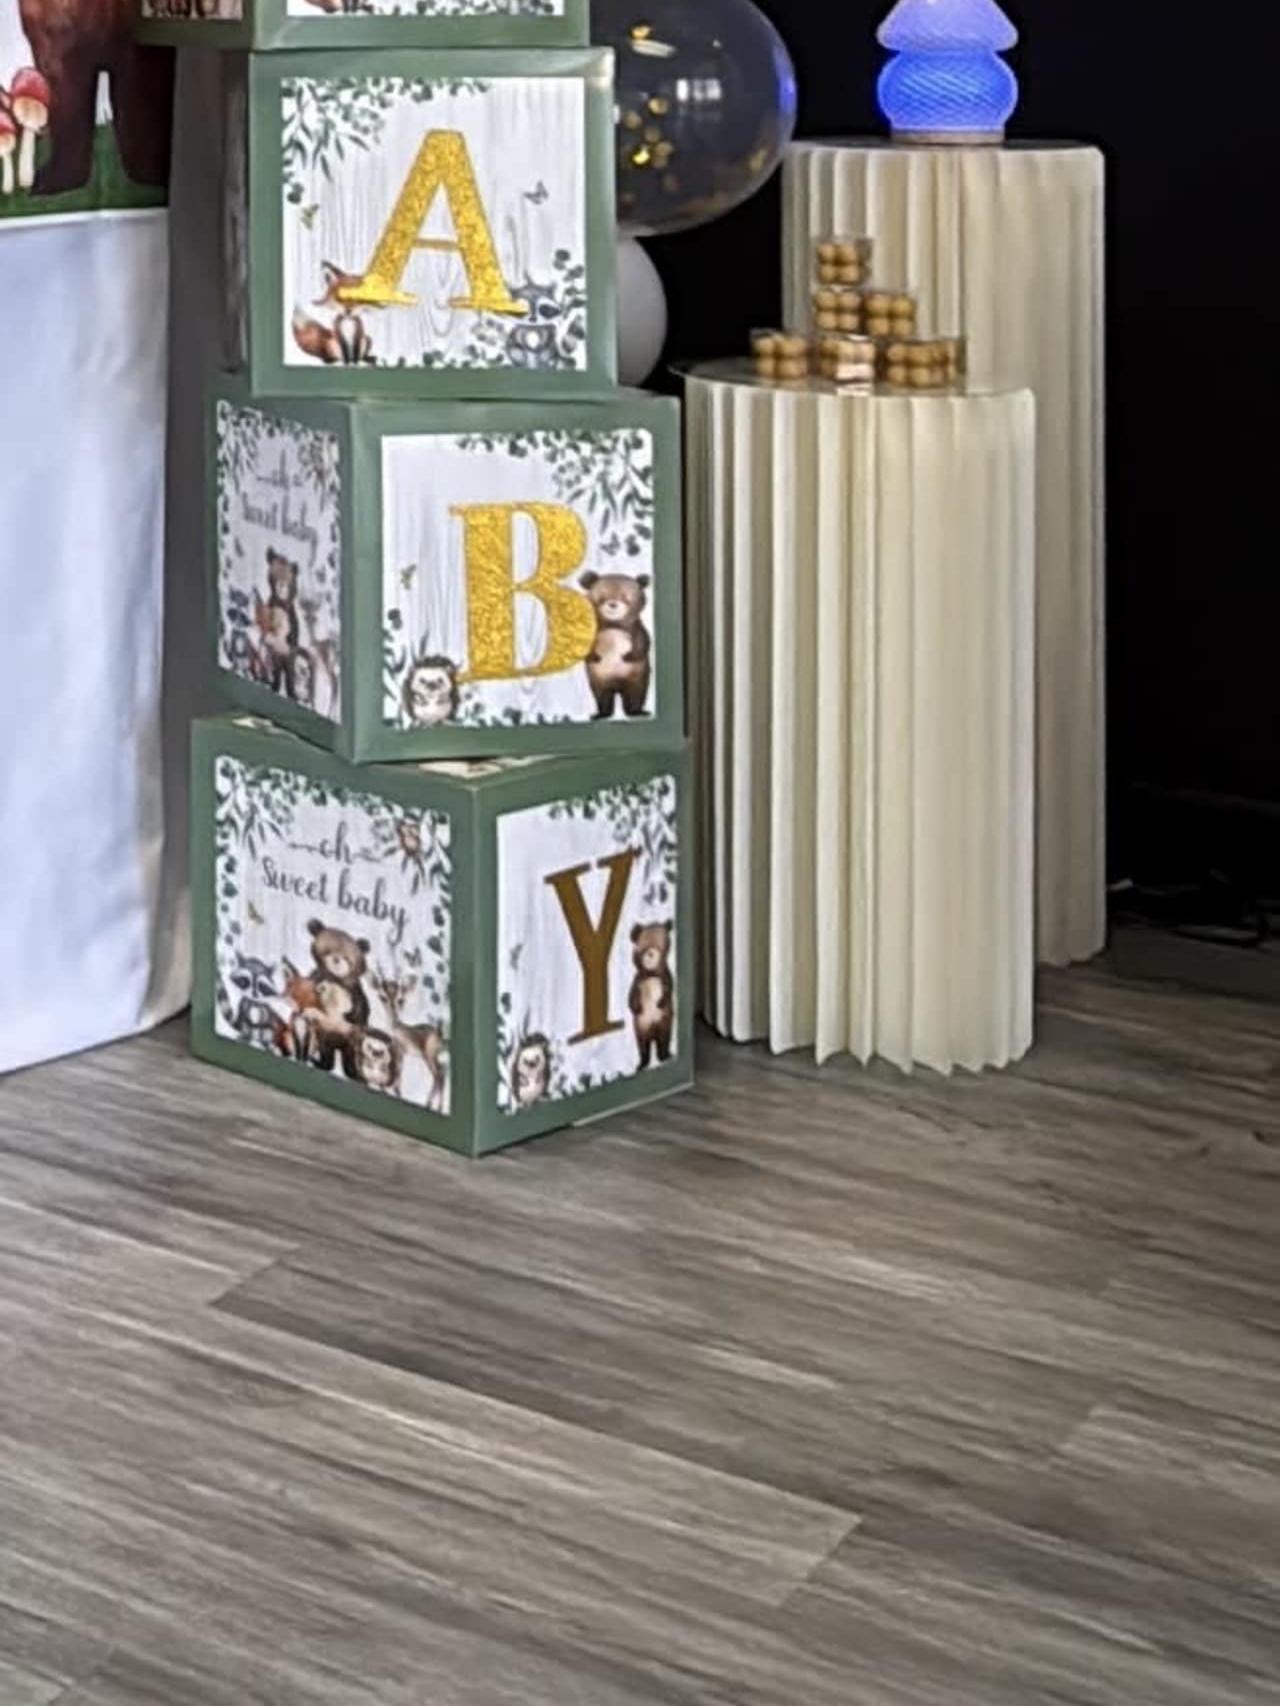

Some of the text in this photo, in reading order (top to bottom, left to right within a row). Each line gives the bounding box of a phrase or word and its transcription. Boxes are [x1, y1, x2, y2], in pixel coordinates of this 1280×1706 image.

[338, 128, 529, 315] A
[449, 500, 598, 685] B
[262, 856, 409, 947] Sweet baby
[544, 845, 641, 1045] Y
